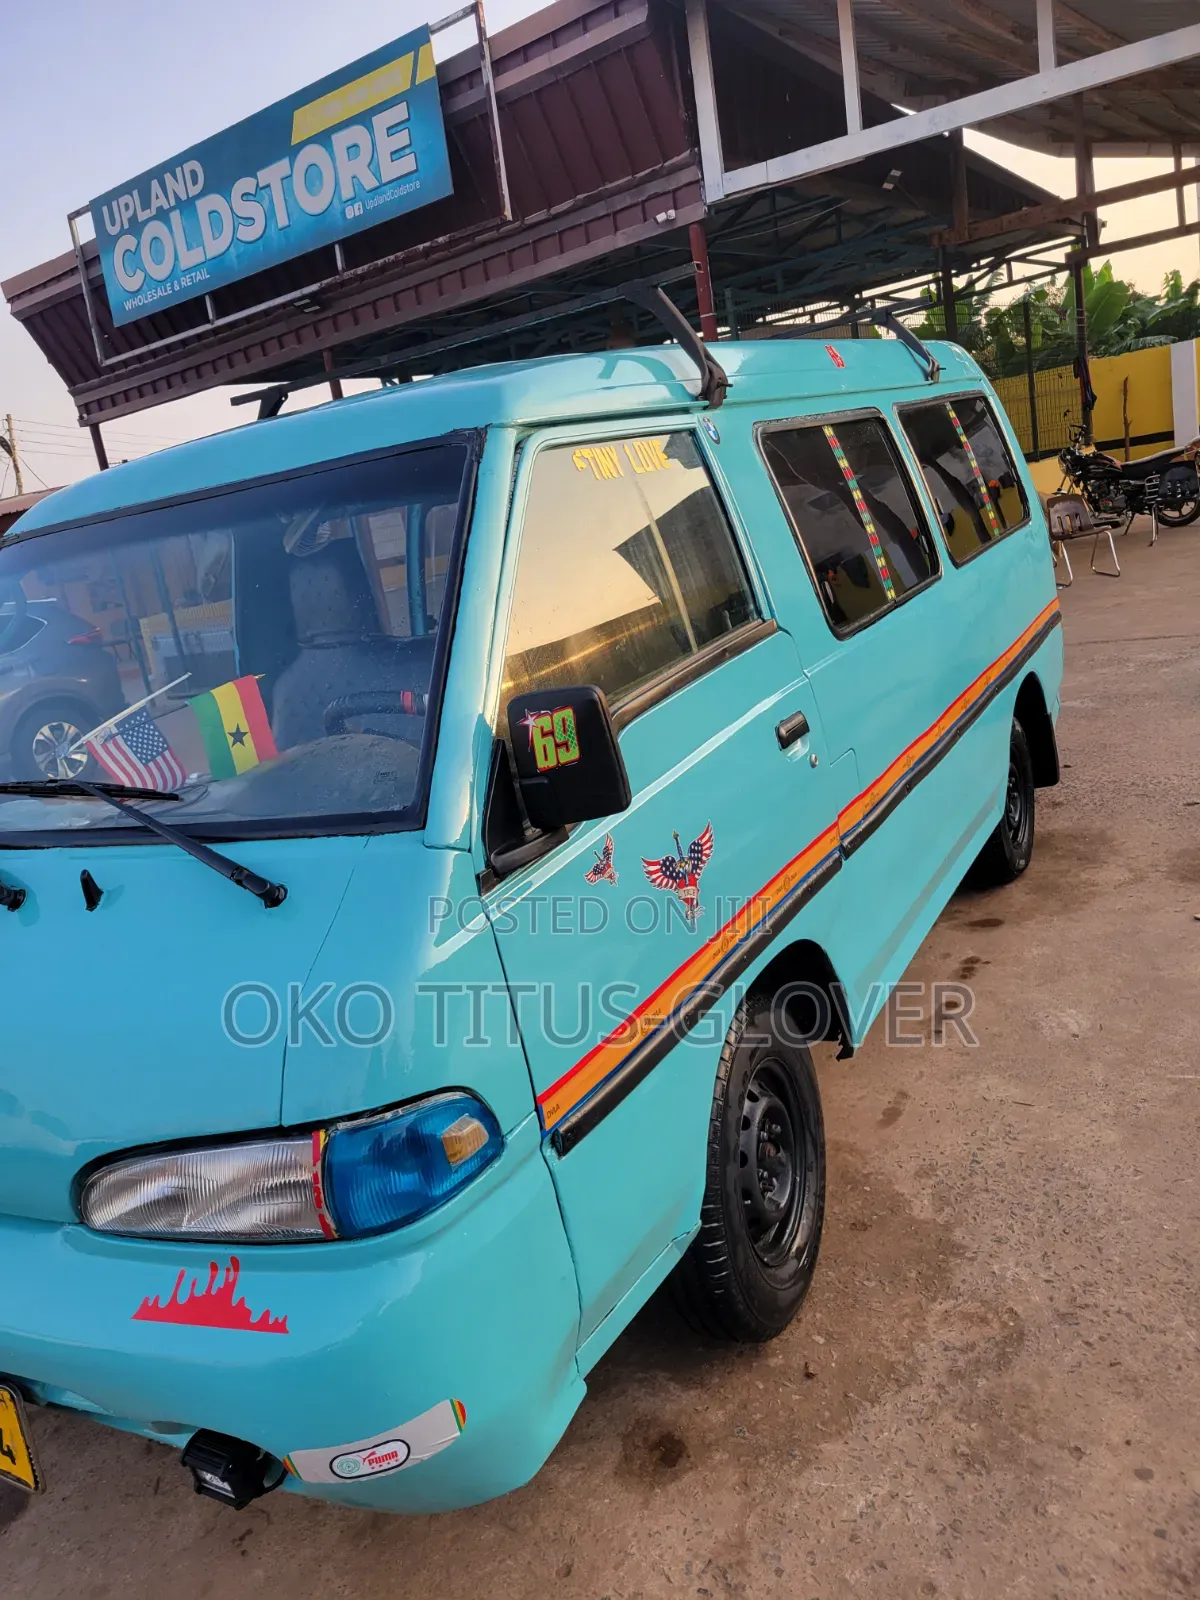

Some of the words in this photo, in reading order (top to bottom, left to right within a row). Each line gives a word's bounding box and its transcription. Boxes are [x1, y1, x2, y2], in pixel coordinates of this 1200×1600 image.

[102, 160, 205, 236] UPLAND
[113, 101, 418, 292] COLDSTORE
[124, 282, 172, 311] WHOLESALE
[173, 280, 180, 291] &
[181, 268, 211, 288] RETAIL
[623, 440, 672, 474] LOVE
[531, 704, 582, 773] 69
[367, 1450, 399, 1466] PUMA
